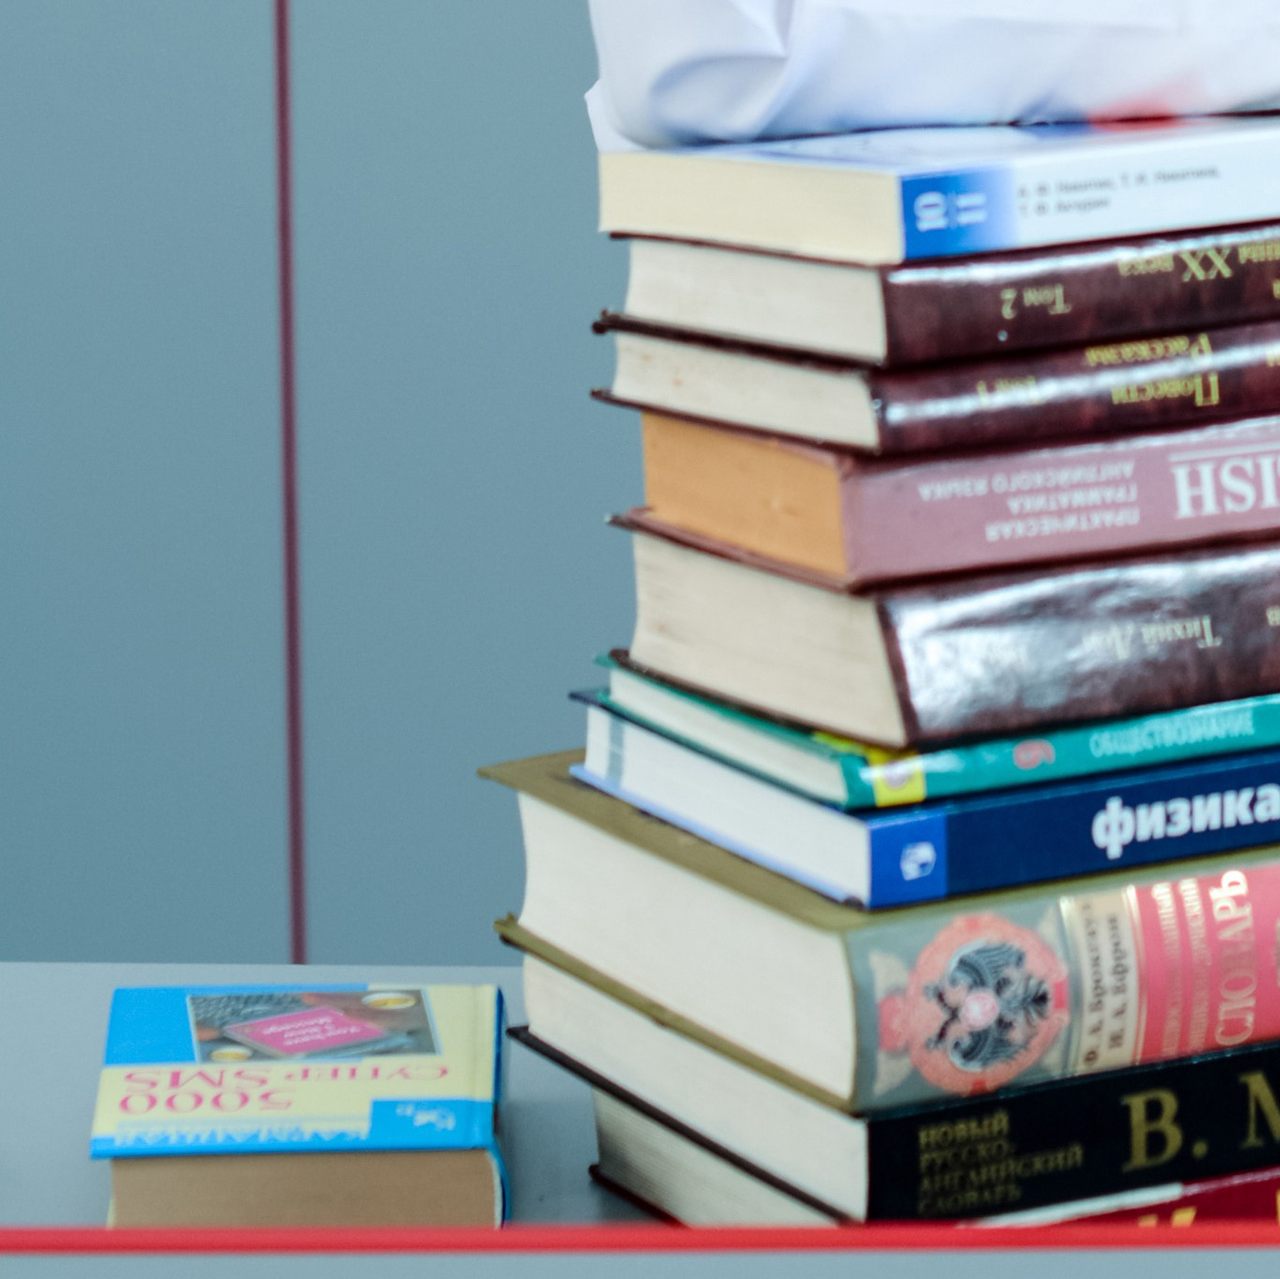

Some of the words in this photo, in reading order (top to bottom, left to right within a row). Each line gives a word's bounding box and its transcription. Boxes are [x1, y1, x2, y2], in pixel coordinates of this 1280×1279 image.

[1118, 251, 1175, 278] века
[1001, 288, 1019, 320] 2
[1023, 283, 1073, 316] Том
[1085, 332, 1215, 367] Рассказы
[1111, 371, 1221, 407] Повести
[917, 474, 989, 503] ЯЗЫКА
[993, 459, 1136, 496] АНГЛИЙСКОГО
[1006, 483, 1138, 516] ГРАММАТИКА
[985, 506, 1141, 542] ПРАКТИЧЕСКАЯ
[1142, 613, 1223, 650] Тихий
[1089, 707, 1256, 757] ОБЩЕСТВОЗНАНИЕ
[1208, 869, 1258, 1047] СЛОВАРЬ
[123, 1066, 269, 1092] SMS
[286, 1064, 448, 1081] СУПЕР
[118, 1090, 294, 1115] 5000
[919, 1108, 1011, 1145] НОВЫЙ
[1121, 1087, 1209, 1173] В.
